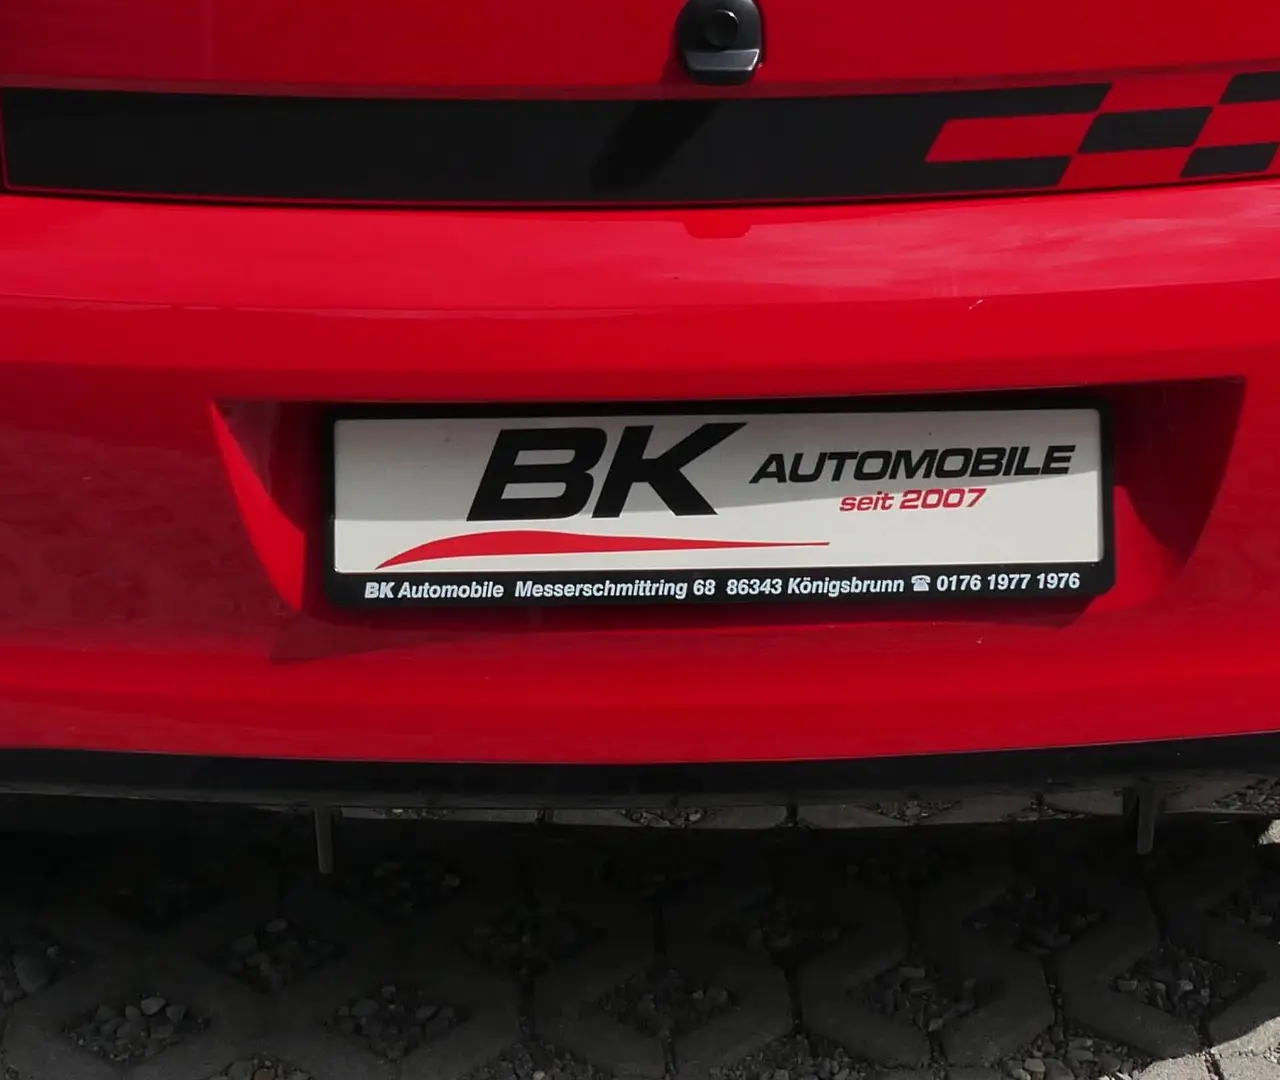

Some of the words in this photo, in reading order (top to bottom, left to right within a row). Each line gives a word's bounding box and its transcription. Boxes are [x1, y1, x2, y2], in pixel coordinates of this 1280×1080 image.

[466, 421, 748, 522] BK
[749, 445, 1076, 484] AUTOMOBILE
[839, 489, 897, 512] seit
[899, 487, 987, 511] 2007
[364, 580, 395, 599] BK
[397, 580, 504, 599] Automobile
[515, 579, 688, 600] Messerschmittring
[692, 579, 715, 595] 68
[725, 578, 782, 595] 86343
[787, 576, 905, 598] Königsbrunn
[936, 574, 982, 592] 0176
[987, 573, 1032, 591] 1977
[1036, 572, 1081, 590] 1976
